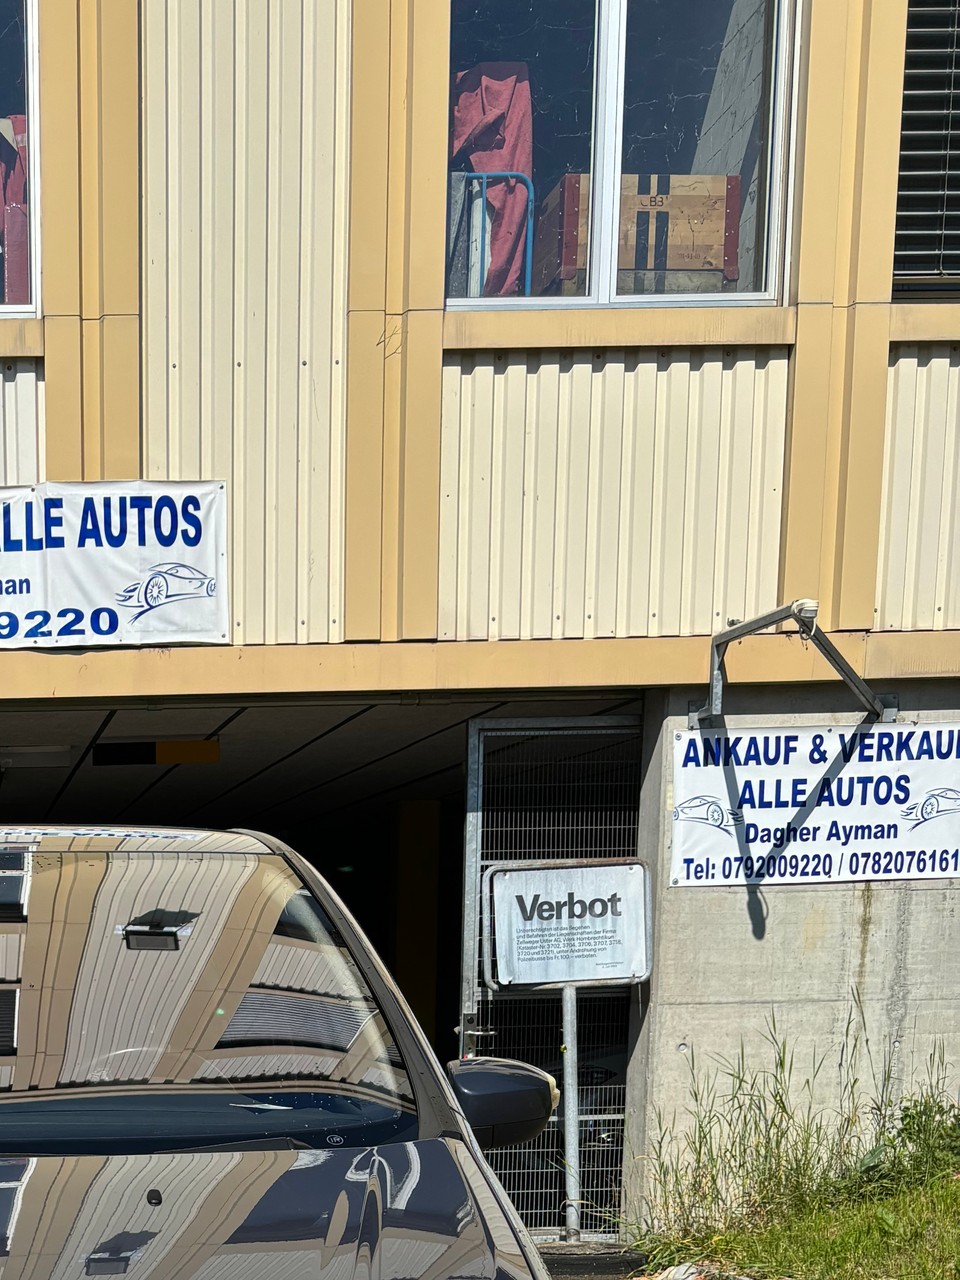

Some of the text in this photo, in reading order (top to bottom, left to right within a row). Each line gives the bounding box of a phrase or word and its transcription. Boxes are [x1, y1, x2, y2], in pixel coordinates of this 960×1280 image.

[77, 495, 203, 548] AUTOS
[682, 735, 799, 768] ANKAUF
[808, 734, 828, 765] &
[737, 774, 911, 810] ALLE AUTOS
[745, 820, 898, 848] Dagher Ayman
[683, 849, 959, 880] Tel: 0792009220 / 0782076161
[515, 892, 622, 921] Verbot
